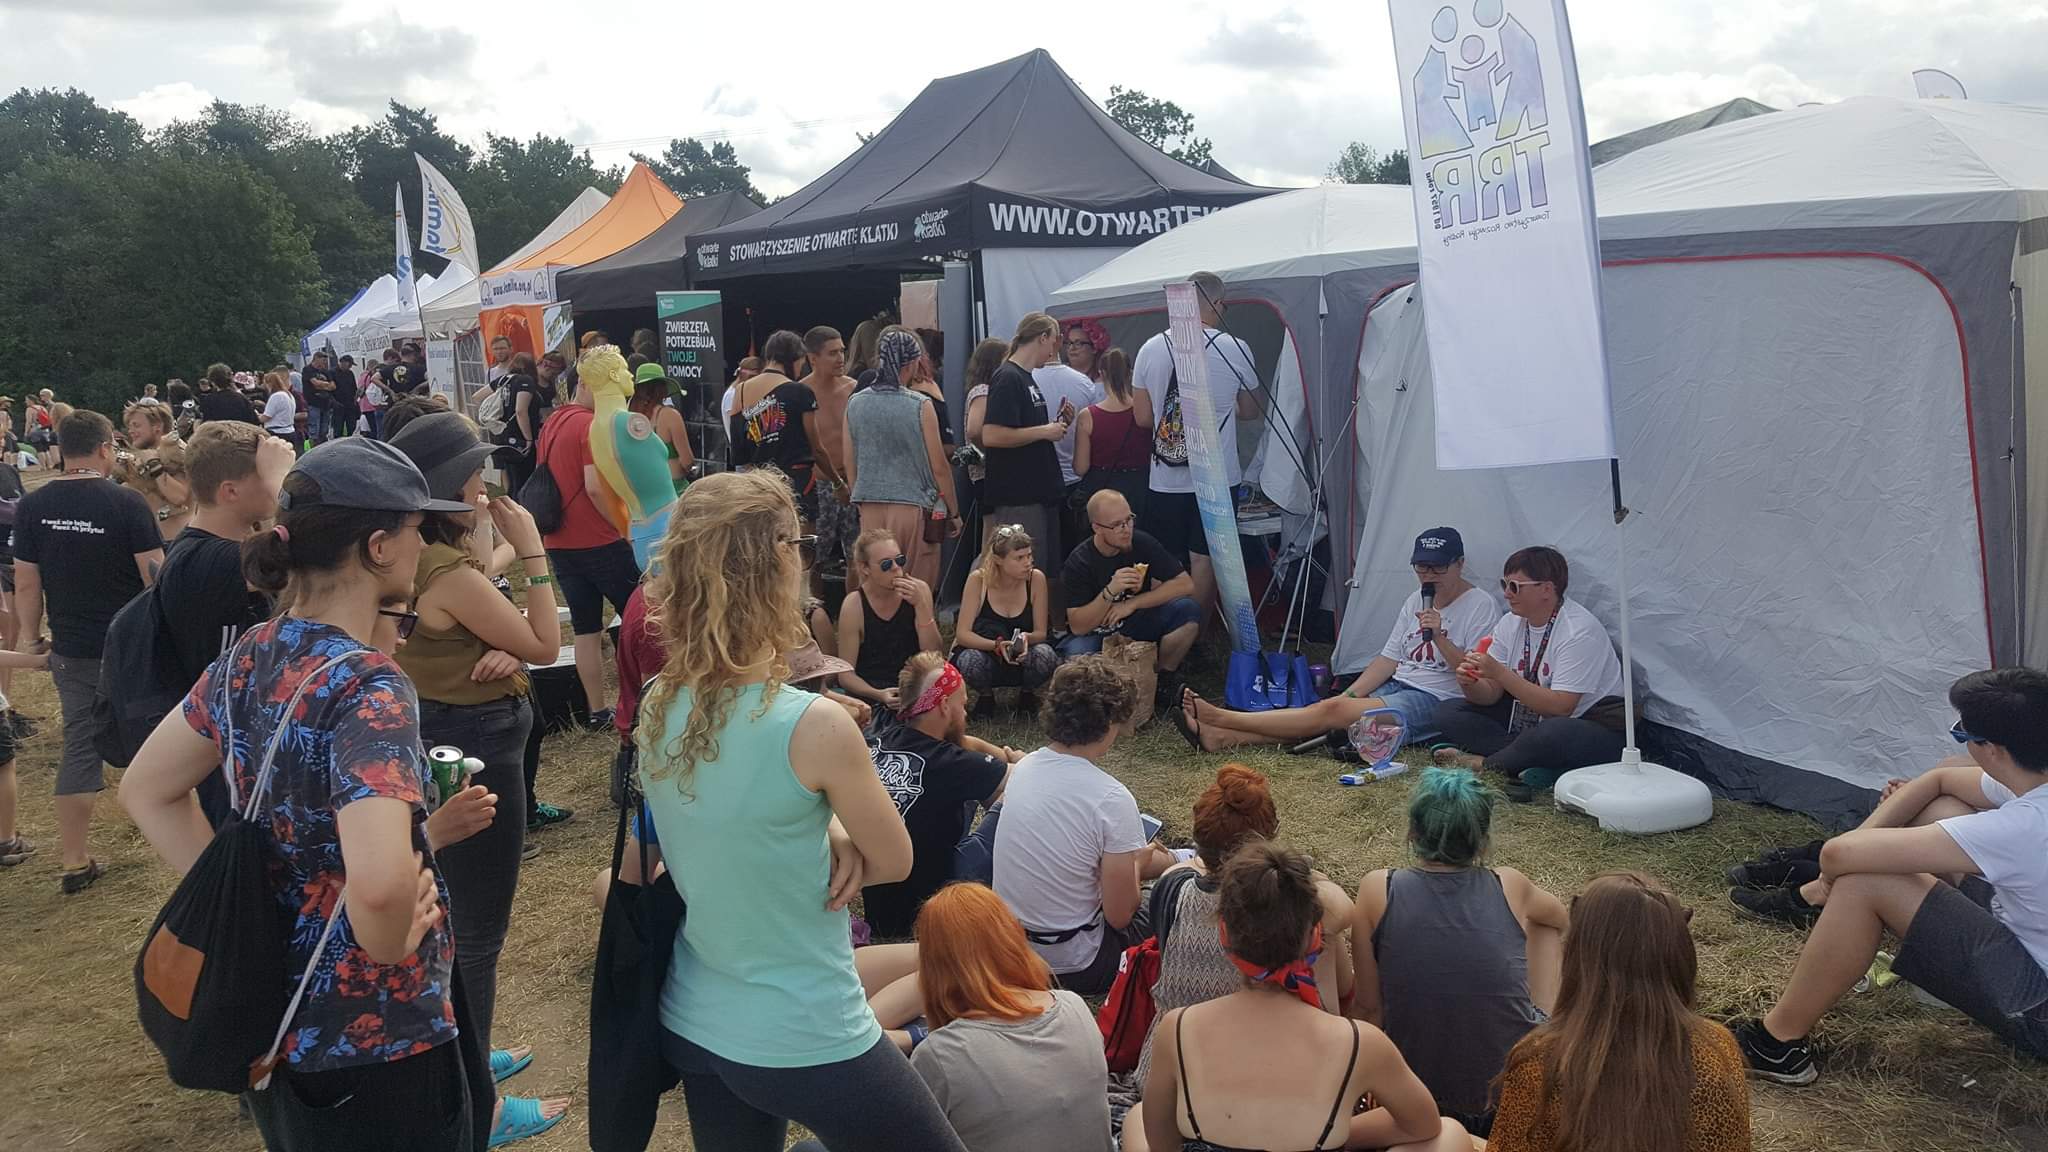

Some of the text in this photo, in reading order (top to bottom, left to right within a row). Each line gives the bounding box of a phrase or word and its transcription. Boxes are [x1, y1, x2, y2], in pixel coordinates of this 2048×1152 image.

[729, 222, 899, 262] STOWARZYSZENIE OTWARTE KLATKI
[665, 321, 710, 336] ZWIERZĘTA
[665, 336, 716, 352] POTRZEBUJĄ
[667, 351, 697, 362] TWOJEJ
[667, 366, 702, 378] POMOCY
